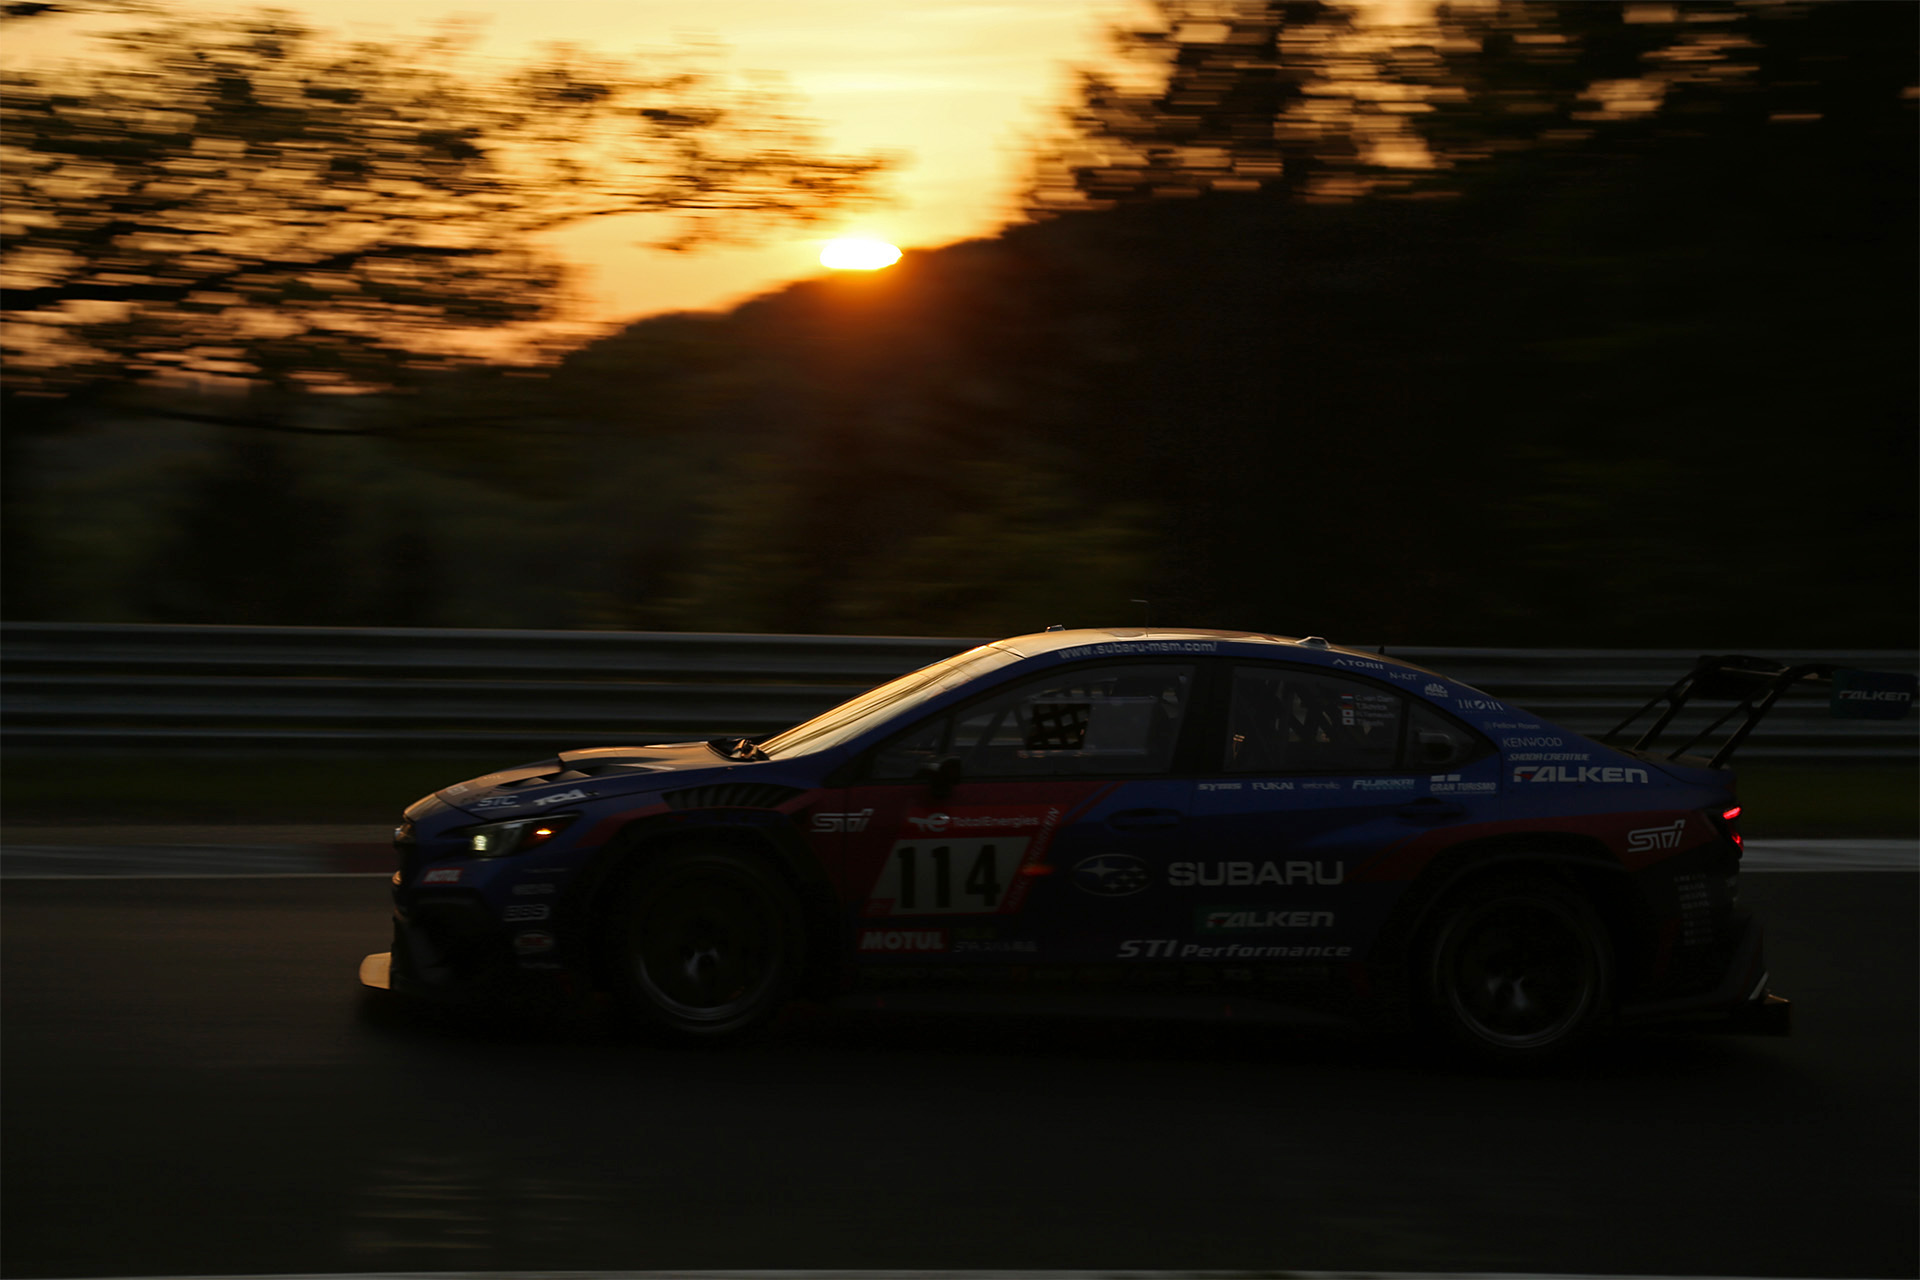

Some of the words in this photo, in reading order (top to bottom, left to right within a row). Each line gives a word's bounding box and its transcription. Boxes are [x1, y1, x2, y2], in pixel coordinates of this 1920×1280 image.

[1838, 689, 1910, 701] FALKEN
[1502, 737, 1563, 749] KENWOOD
[1512, 766, 1649, 784] FALKEN
[1430, 782, 1455, 793] GRAN
[1456, 782, 1496, 793] TURISMO
[950, 815, 1040, 828] TotalEnergies
[899, 844, 1000, 908] 114
[1168, 860, 1345, 886] SUBARU
[1206, 911, 1335, 928] FALKEN
[861, 931, 945, 950] MOTUL
[1117, 939, 1178, 958] STI
[1181, 943, 1352, 957] Performance
